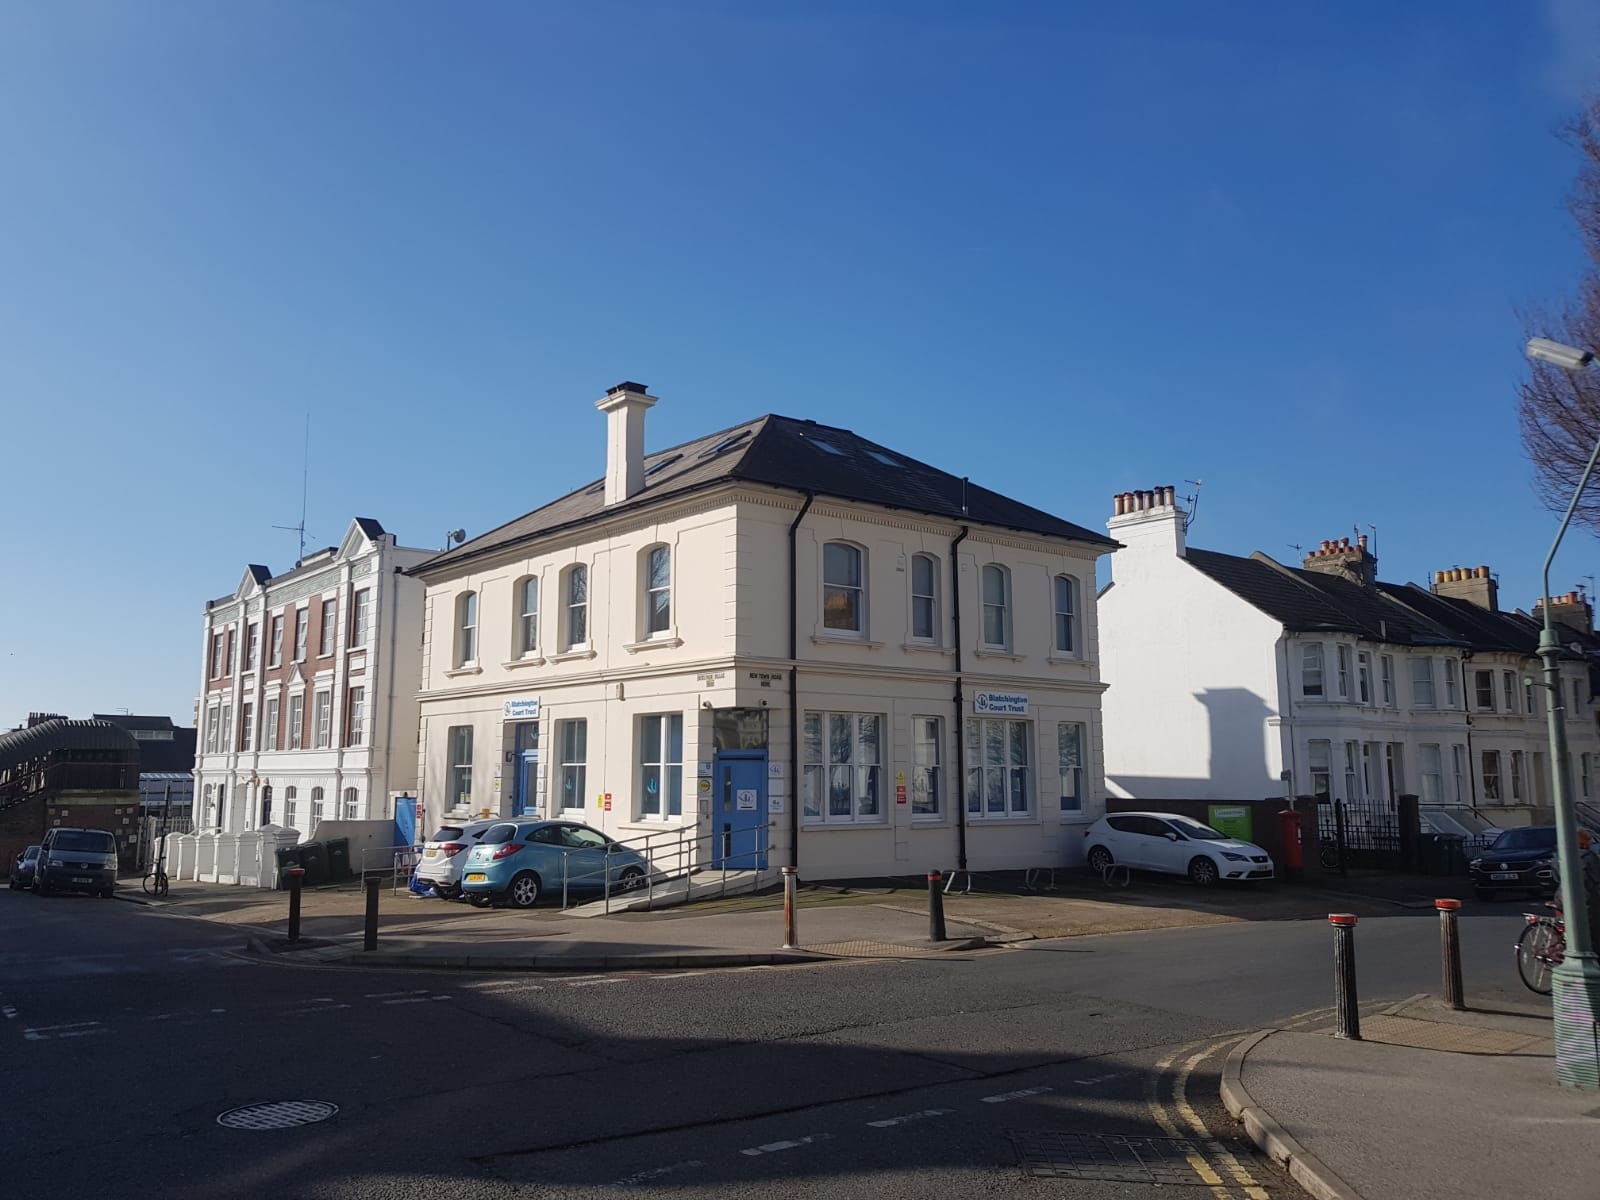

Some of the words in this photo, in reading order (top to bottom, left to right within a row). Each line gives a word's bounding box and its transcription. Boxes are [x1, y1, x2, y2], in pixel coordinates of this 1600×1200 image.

[989, 694, 1028, 705] Blatchington
[989, 703, 1007, 711] Court
[1008, 704, 1025, 713] Trust
